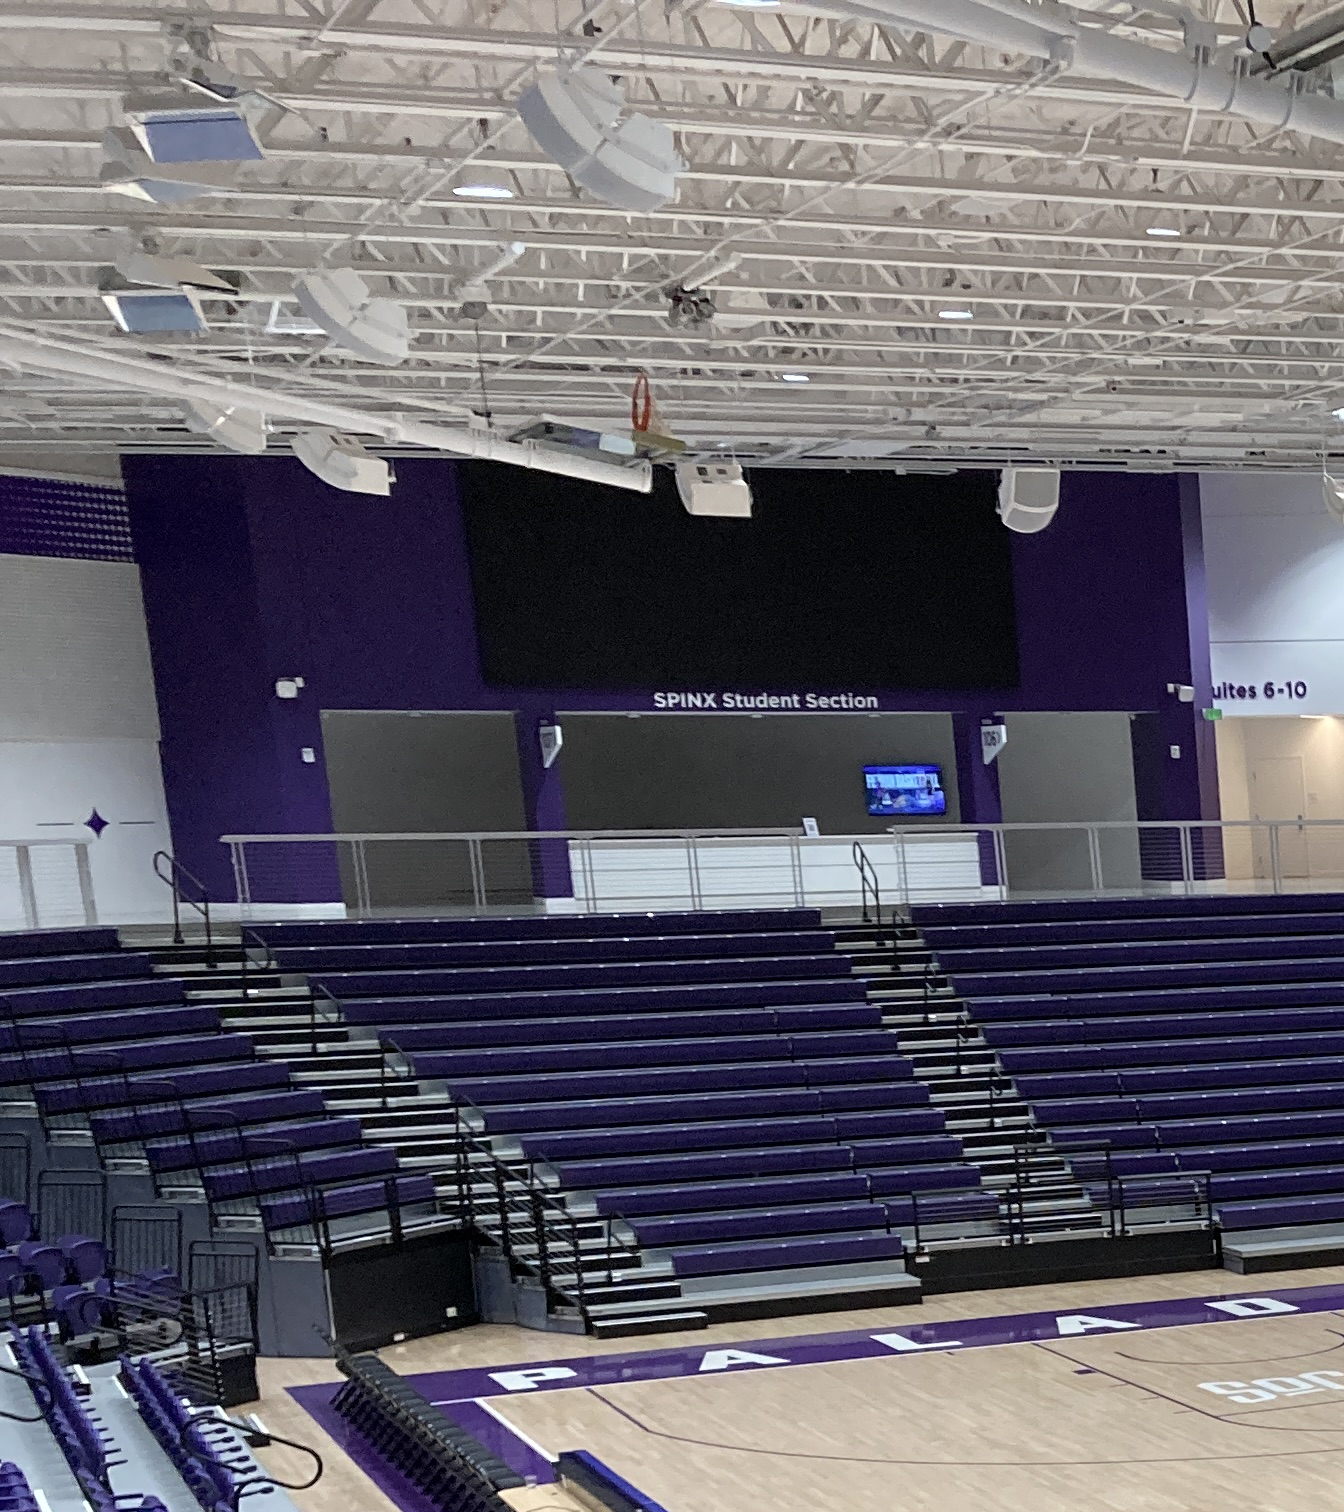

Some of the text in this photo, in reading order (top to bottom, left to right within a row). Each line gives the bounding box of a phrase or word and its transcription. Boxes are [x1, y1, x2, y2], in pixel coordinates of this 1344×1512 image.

[1212, 681, 1307, 700] uites 6-10
[653, 692, 879, 709] SPINX Student Section
